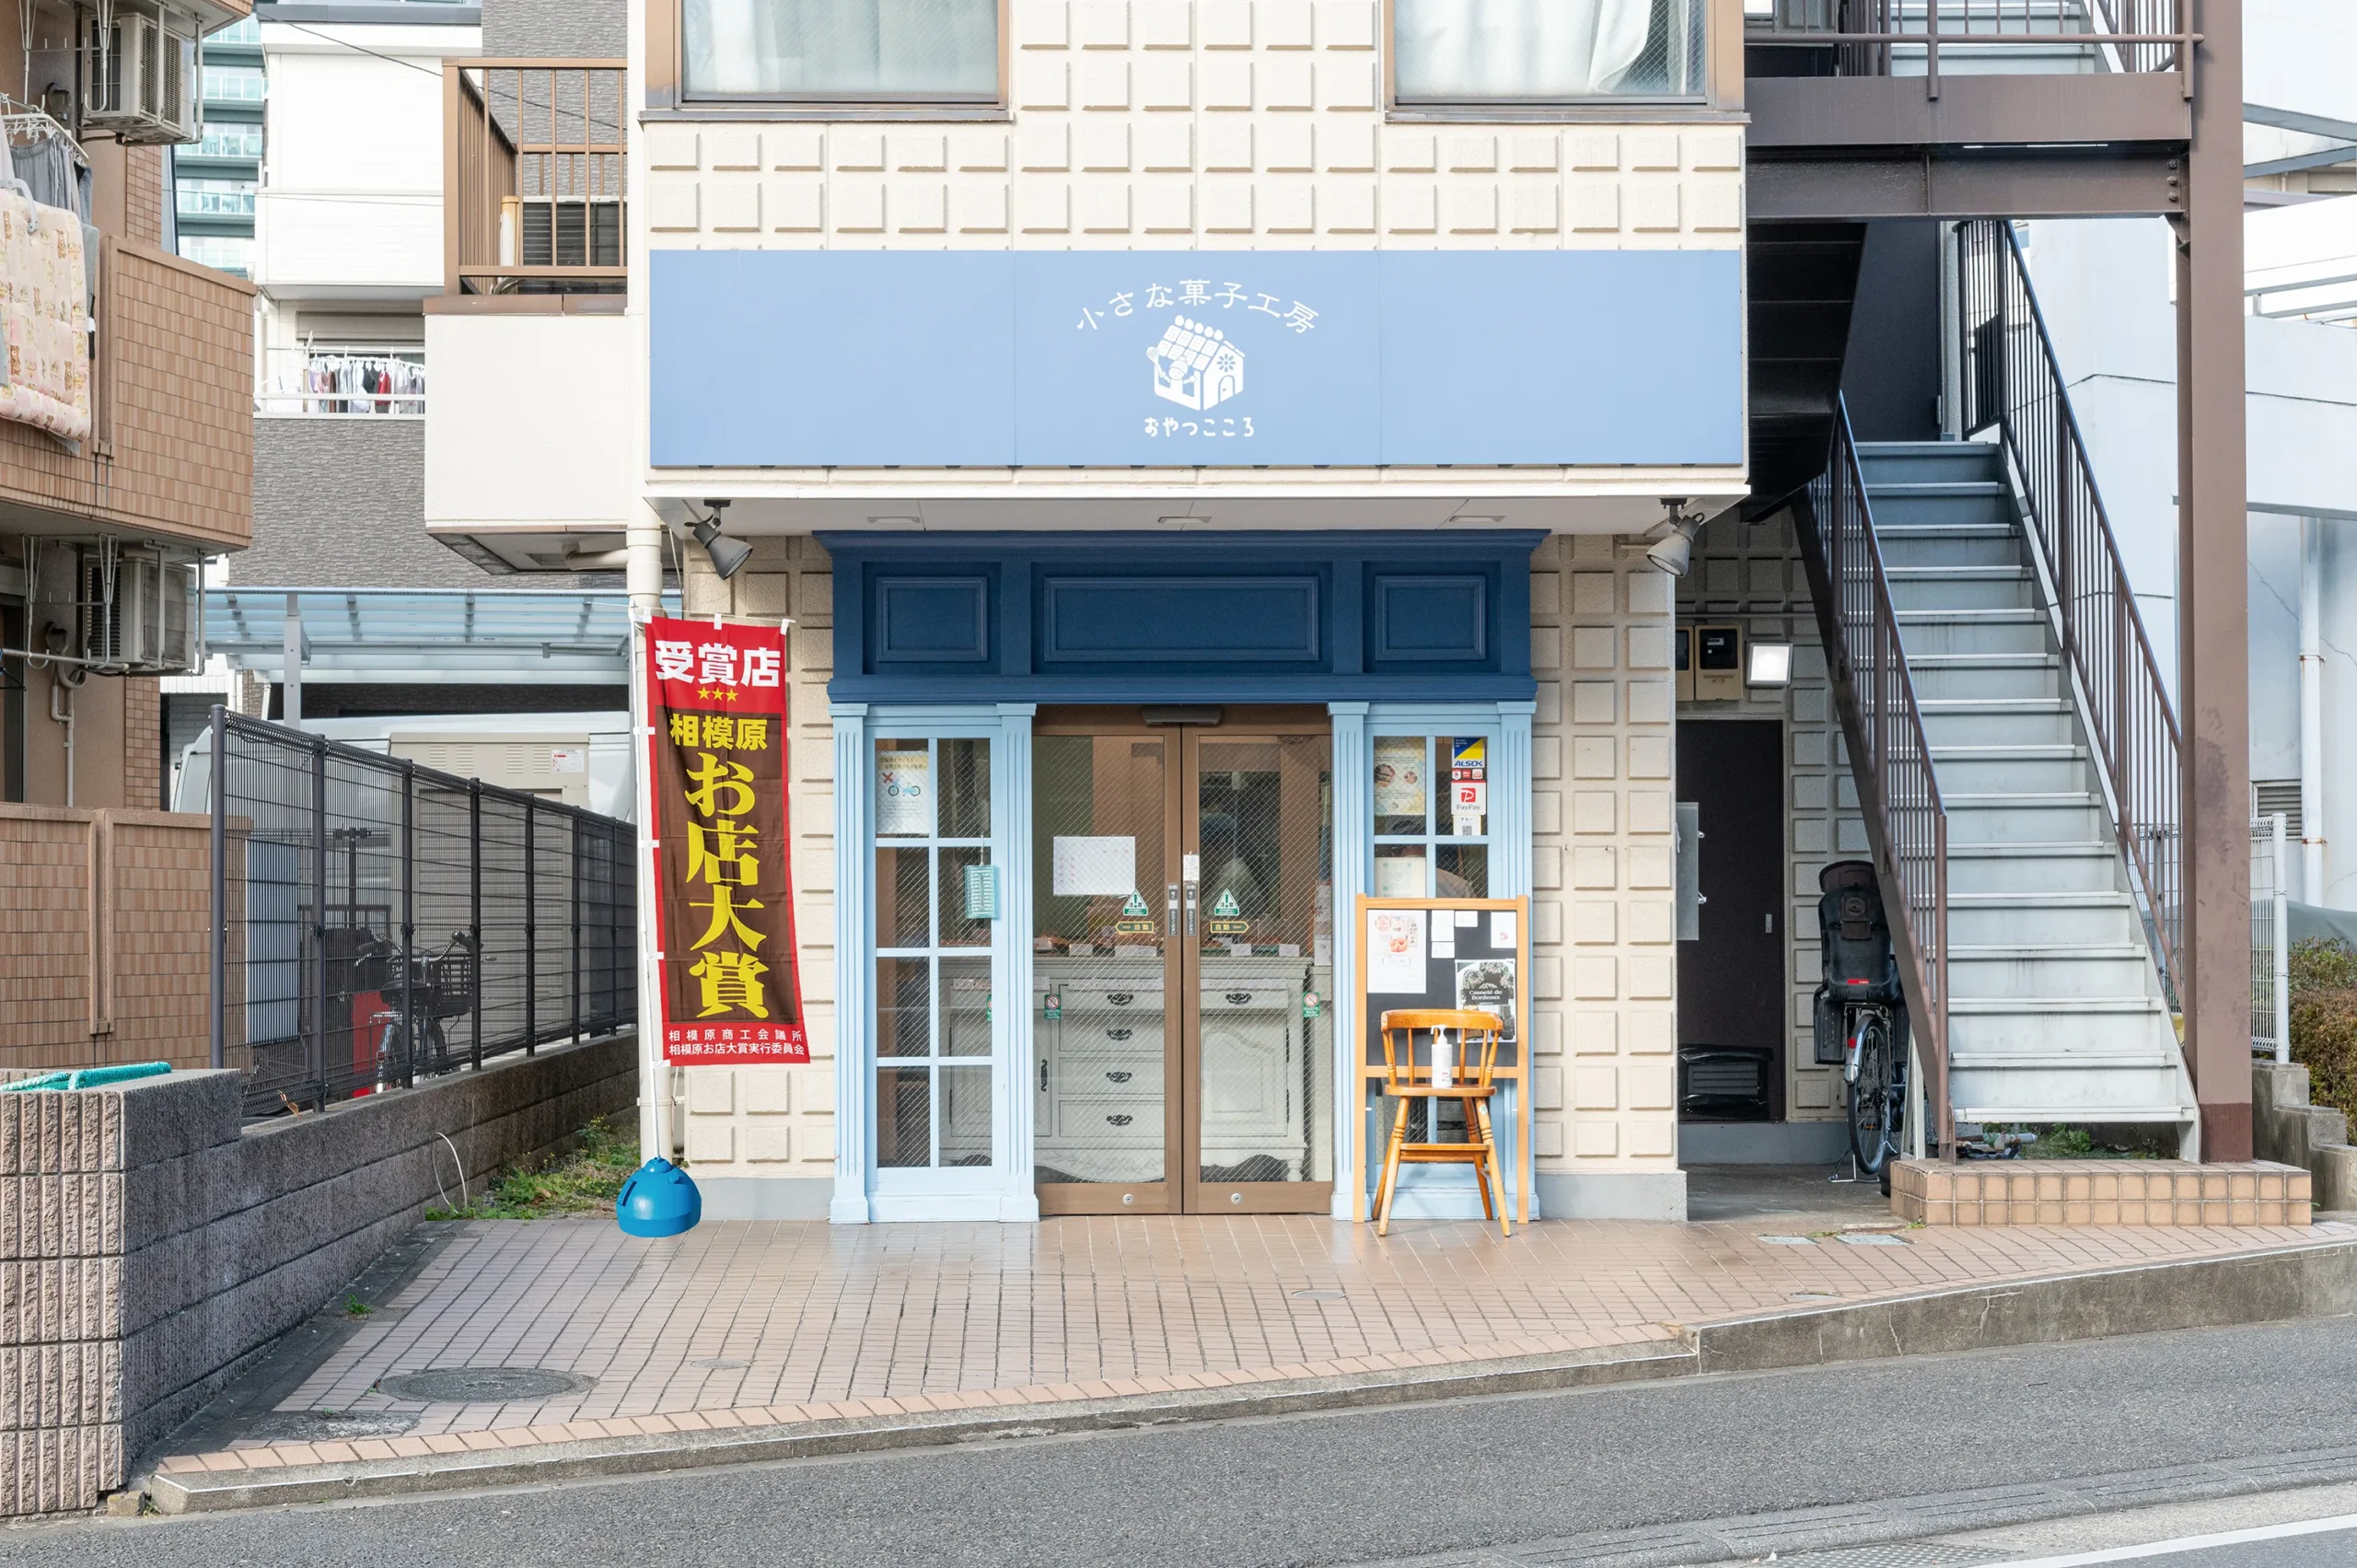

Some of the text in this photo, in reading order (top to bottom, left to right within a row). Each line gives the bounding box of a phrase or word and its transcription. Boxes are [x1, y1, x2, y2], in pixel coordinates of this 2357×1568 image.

[1076, 279, 1319, 333] 小さな菓子工房
[1144, 417, 1254, 437] おやつこころ
[655, 640, 781, 687] 受賞店
[670, 713, 768, 750] 相模原
[684, 751, 770, 1019] お店大賞
[668, 1028, 802, 1042] 相模原商工会議所
[668, 1042, 805, 1056] 相模原お店大賞実行委員会
